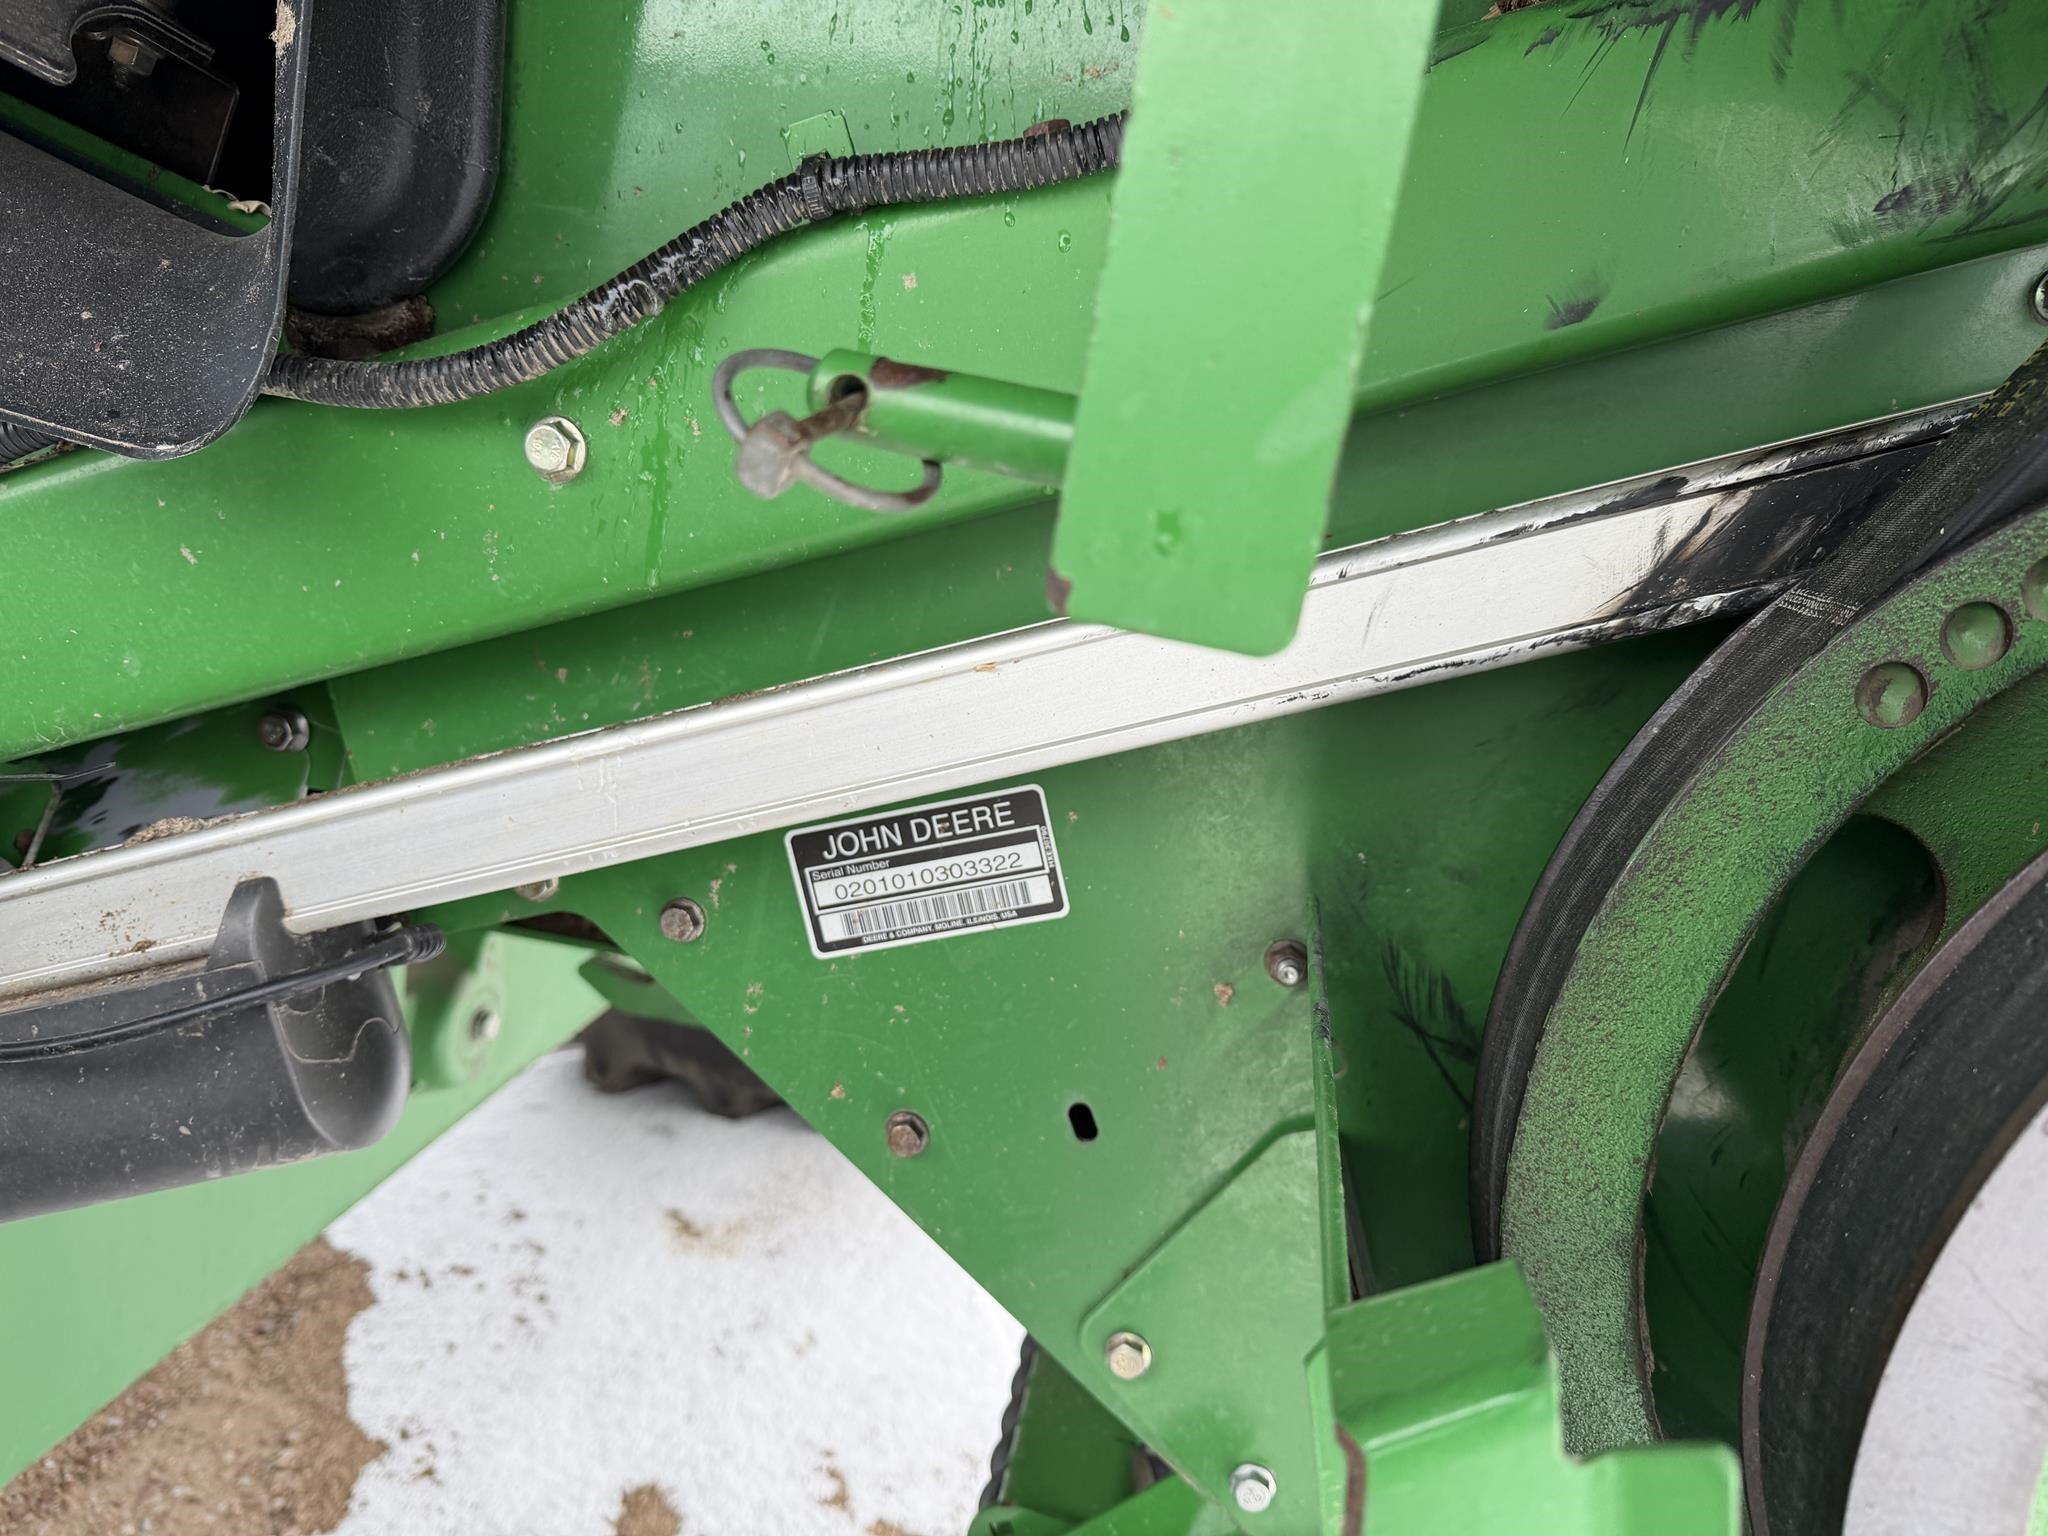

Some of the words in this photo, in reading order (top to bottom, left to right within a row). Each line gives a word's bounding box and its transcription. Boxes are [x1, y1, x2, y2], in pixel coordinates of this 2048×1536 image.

[823, 823, 902, 859] JOHN
[911, 802, 1015, 842] DEERE
[812, 868, 844, 881] Serial
[846, 860, 889, 875] Number
[835, 852, 1023, 899] 0201010303322
[863, 932, 888, 943] DEERE
[1001, 910, 1018, 919] USA
